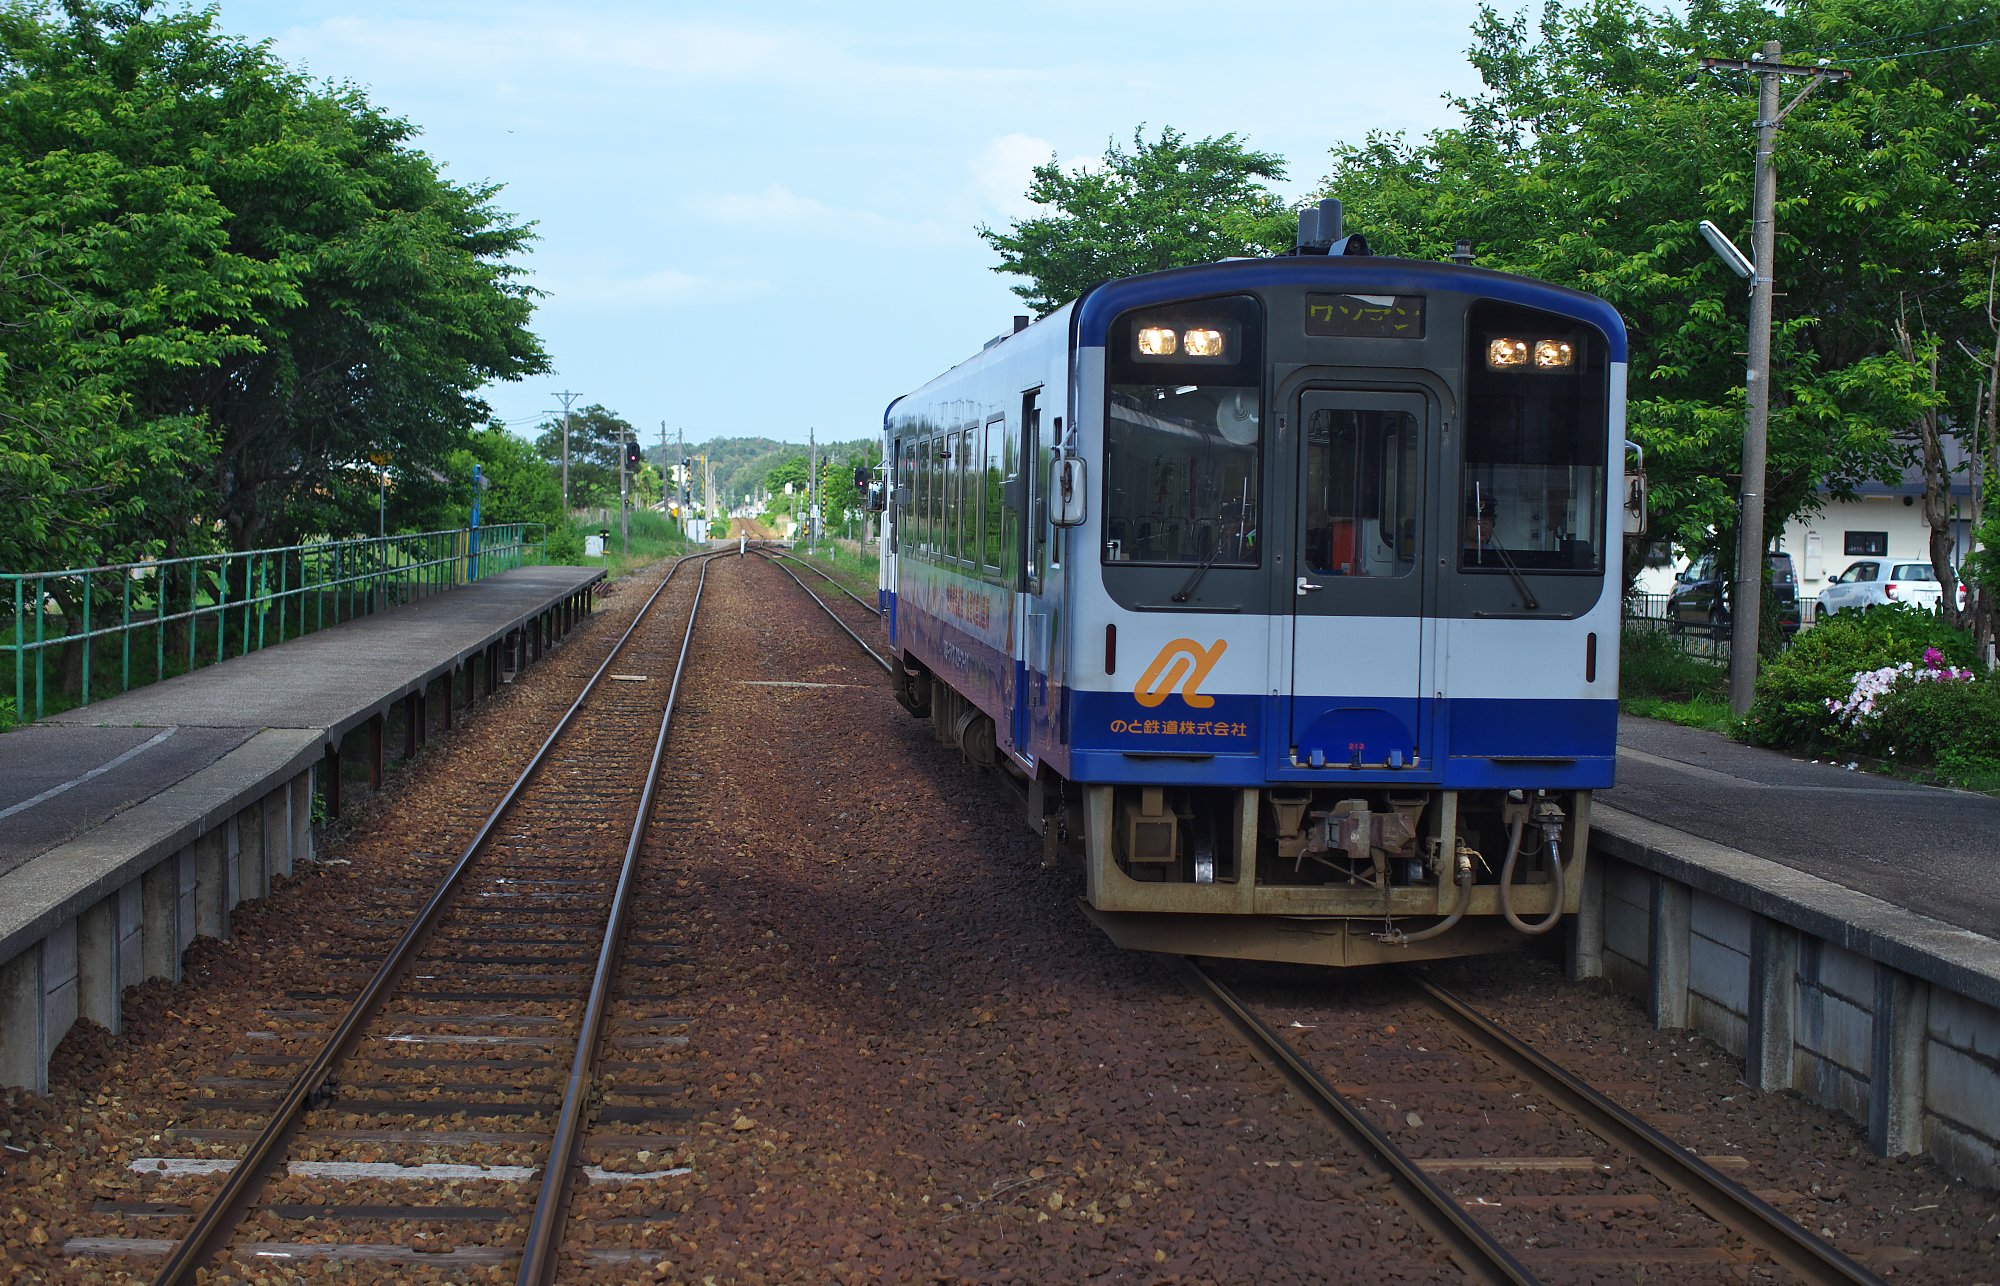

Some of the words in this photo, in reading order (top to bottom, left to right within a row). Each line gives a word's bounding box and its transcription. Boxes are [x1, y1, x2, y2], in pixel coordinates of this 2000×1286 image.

[1110, 719, 1247, 737] のと鉄道株式会社
